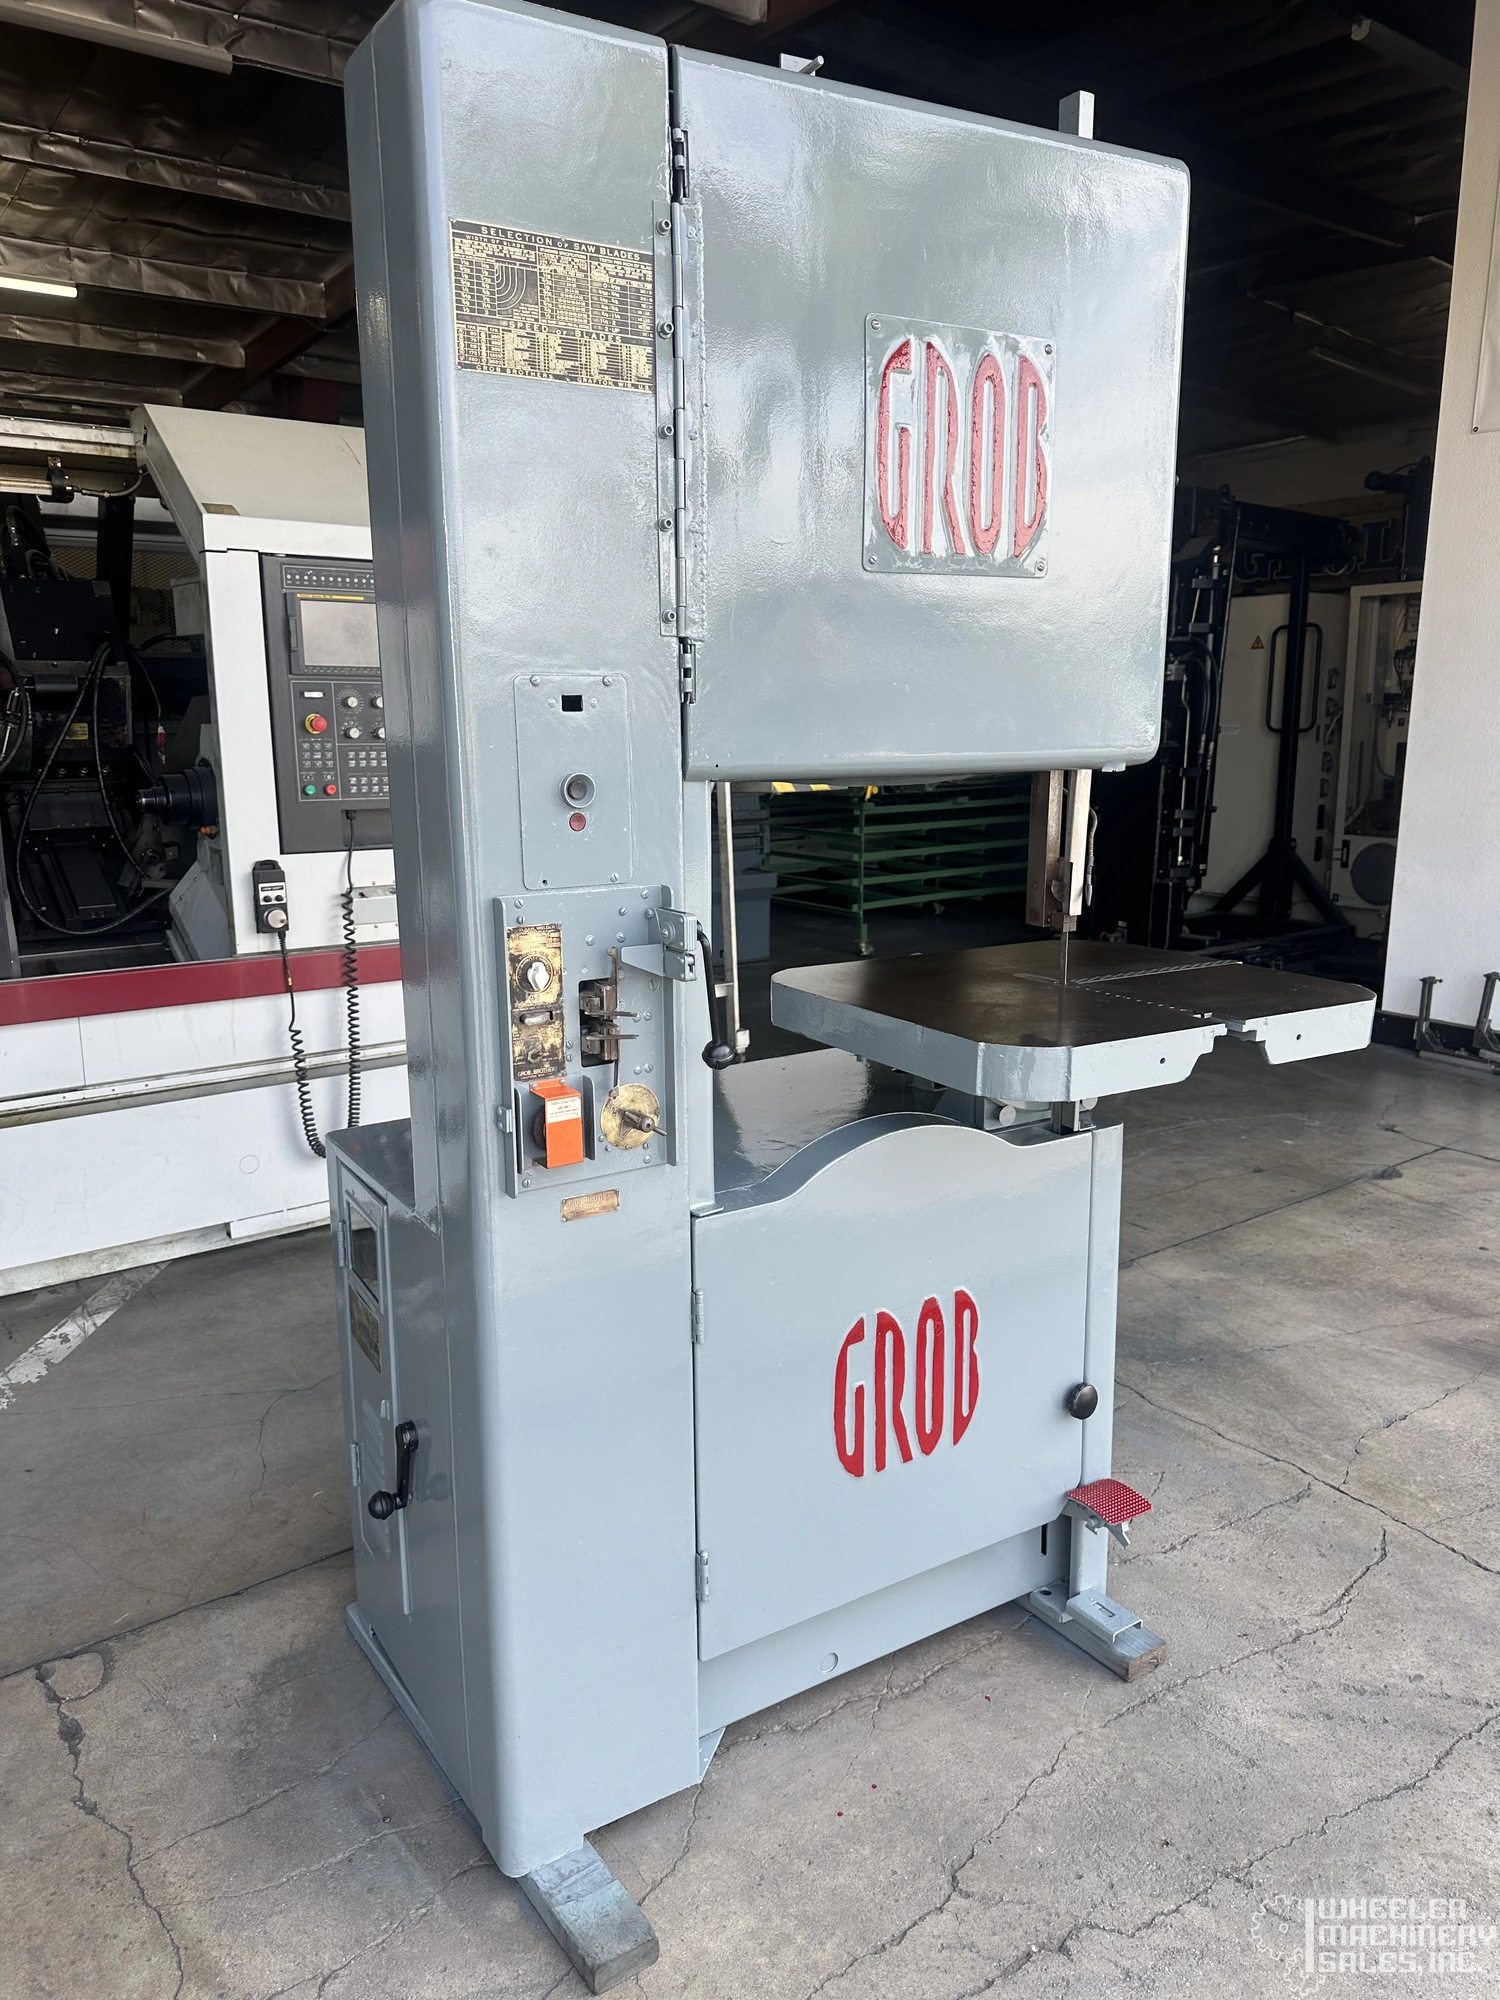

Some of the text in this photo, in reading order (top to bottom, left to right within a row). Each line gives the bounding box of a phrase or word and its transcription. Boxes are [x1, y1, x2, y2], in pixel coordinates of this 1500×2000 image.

[481, 226, 553, 246] SELECTION
[574, 242, 596, 253] SAW
[600, 247, 640, 261] BLADES
[508, 321, 549, 332] SPEED
[575, 330, 622, 344] BLADES
[476, 364, 501, 372] GROB
[877, 338, 1048, 558] GROB
[834, 1288, 979, 1477] GROB
